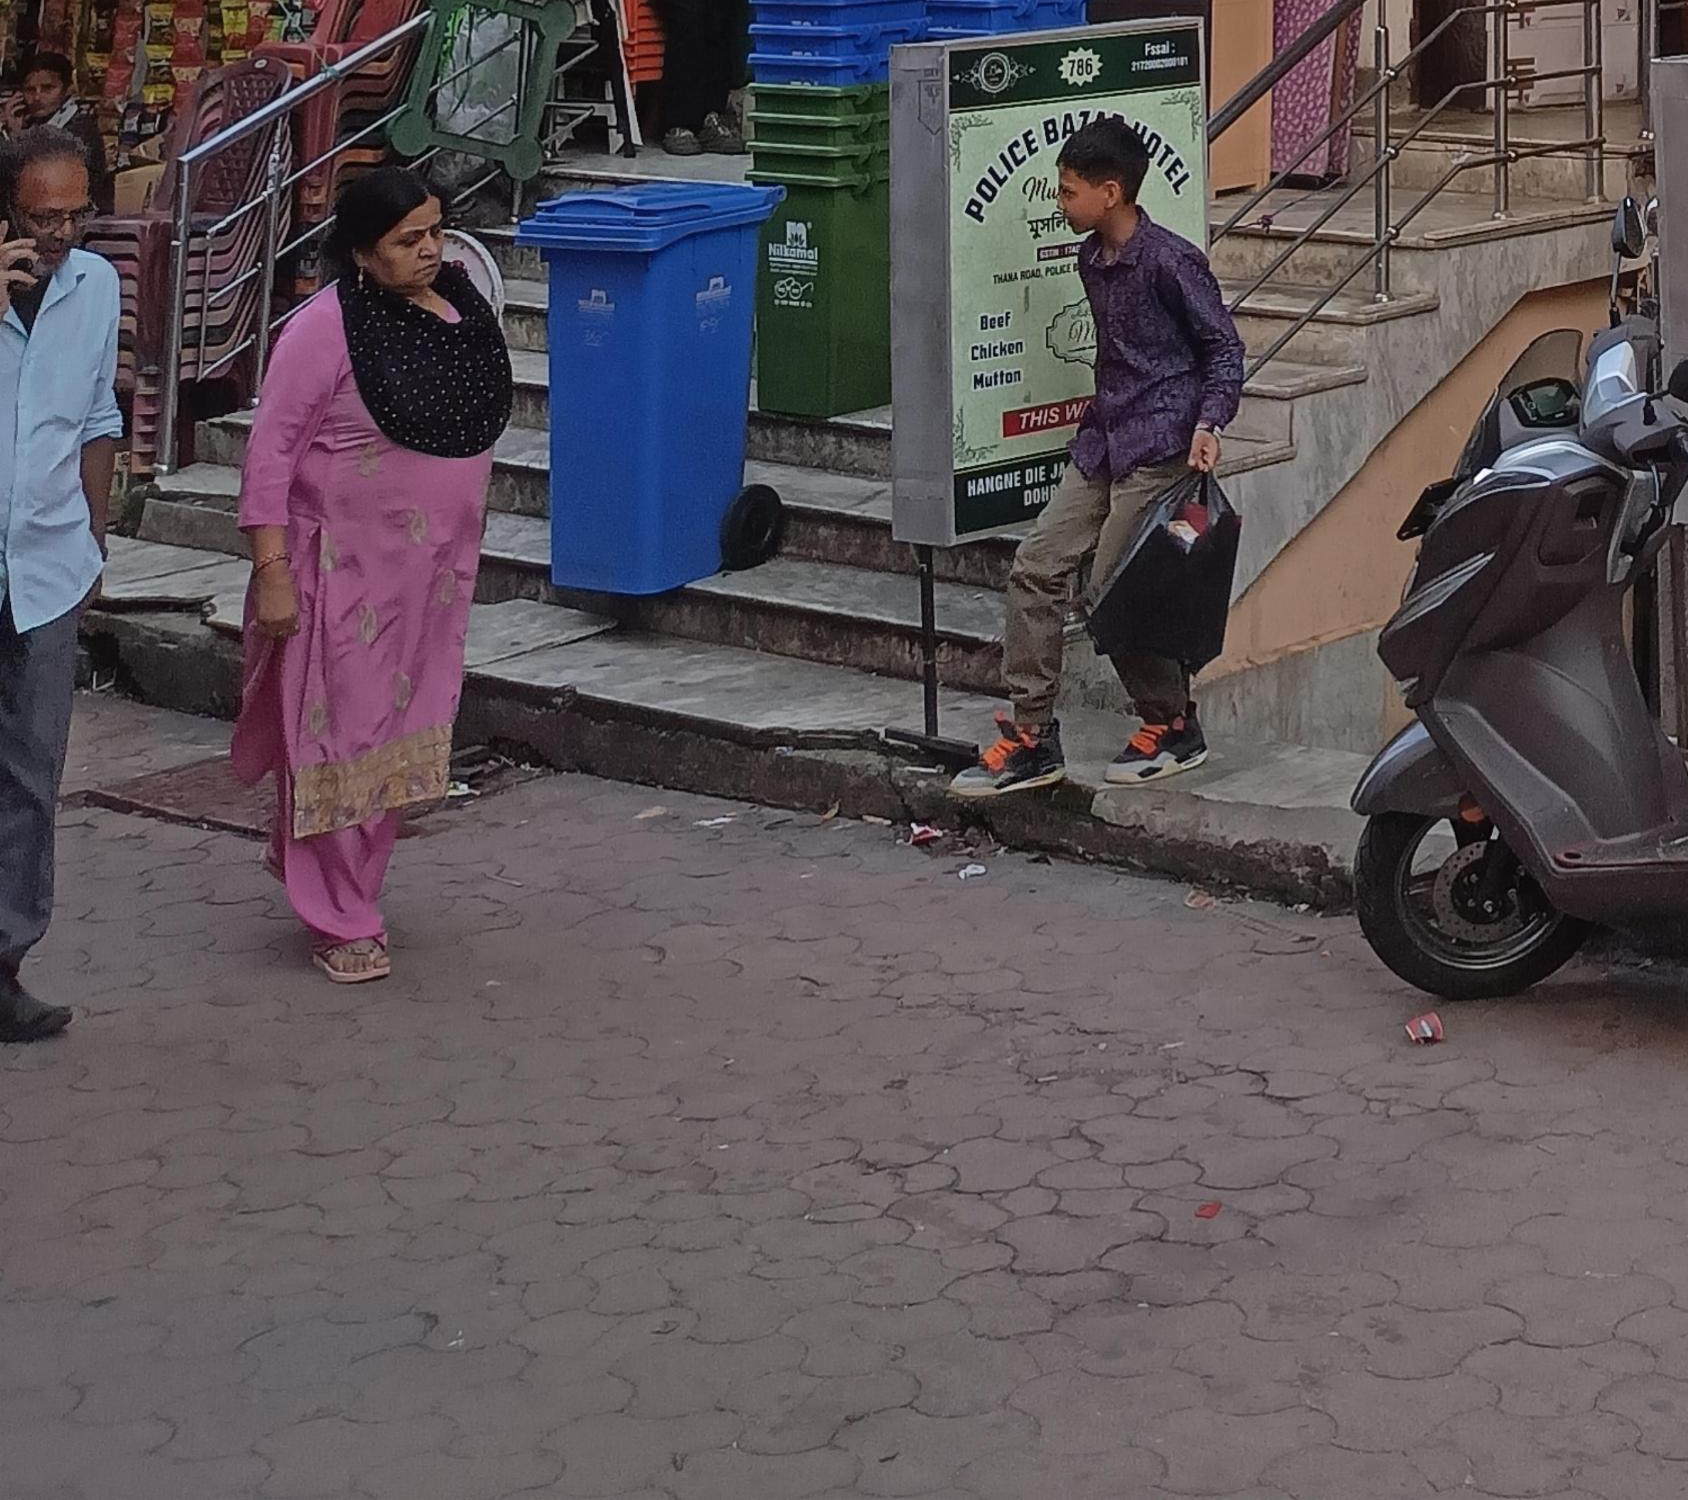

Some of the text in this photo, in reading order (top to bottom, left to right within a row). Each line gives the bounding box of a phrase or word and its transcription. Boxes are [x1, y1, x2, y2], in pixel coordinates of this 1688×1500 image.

[1068, 57, 1093, 77] 786
[964, 128, 1041, 224] POLICE
[1027, 211, 1067, 240] মুসলি
[768, 242, 818, 260] Nilkamal
[993, 272, 1018, 285] THANA
[1045, 264, 1071, 277] POLICE
[971, 341, 1023, 361] Chicken
[973, 370, 1021, 390] Mutton
[1019, 406, 1060, 430] THIS
[967, 470, 1021, 497] HANGNE
[1025, 465, 1046, 485] DIE
